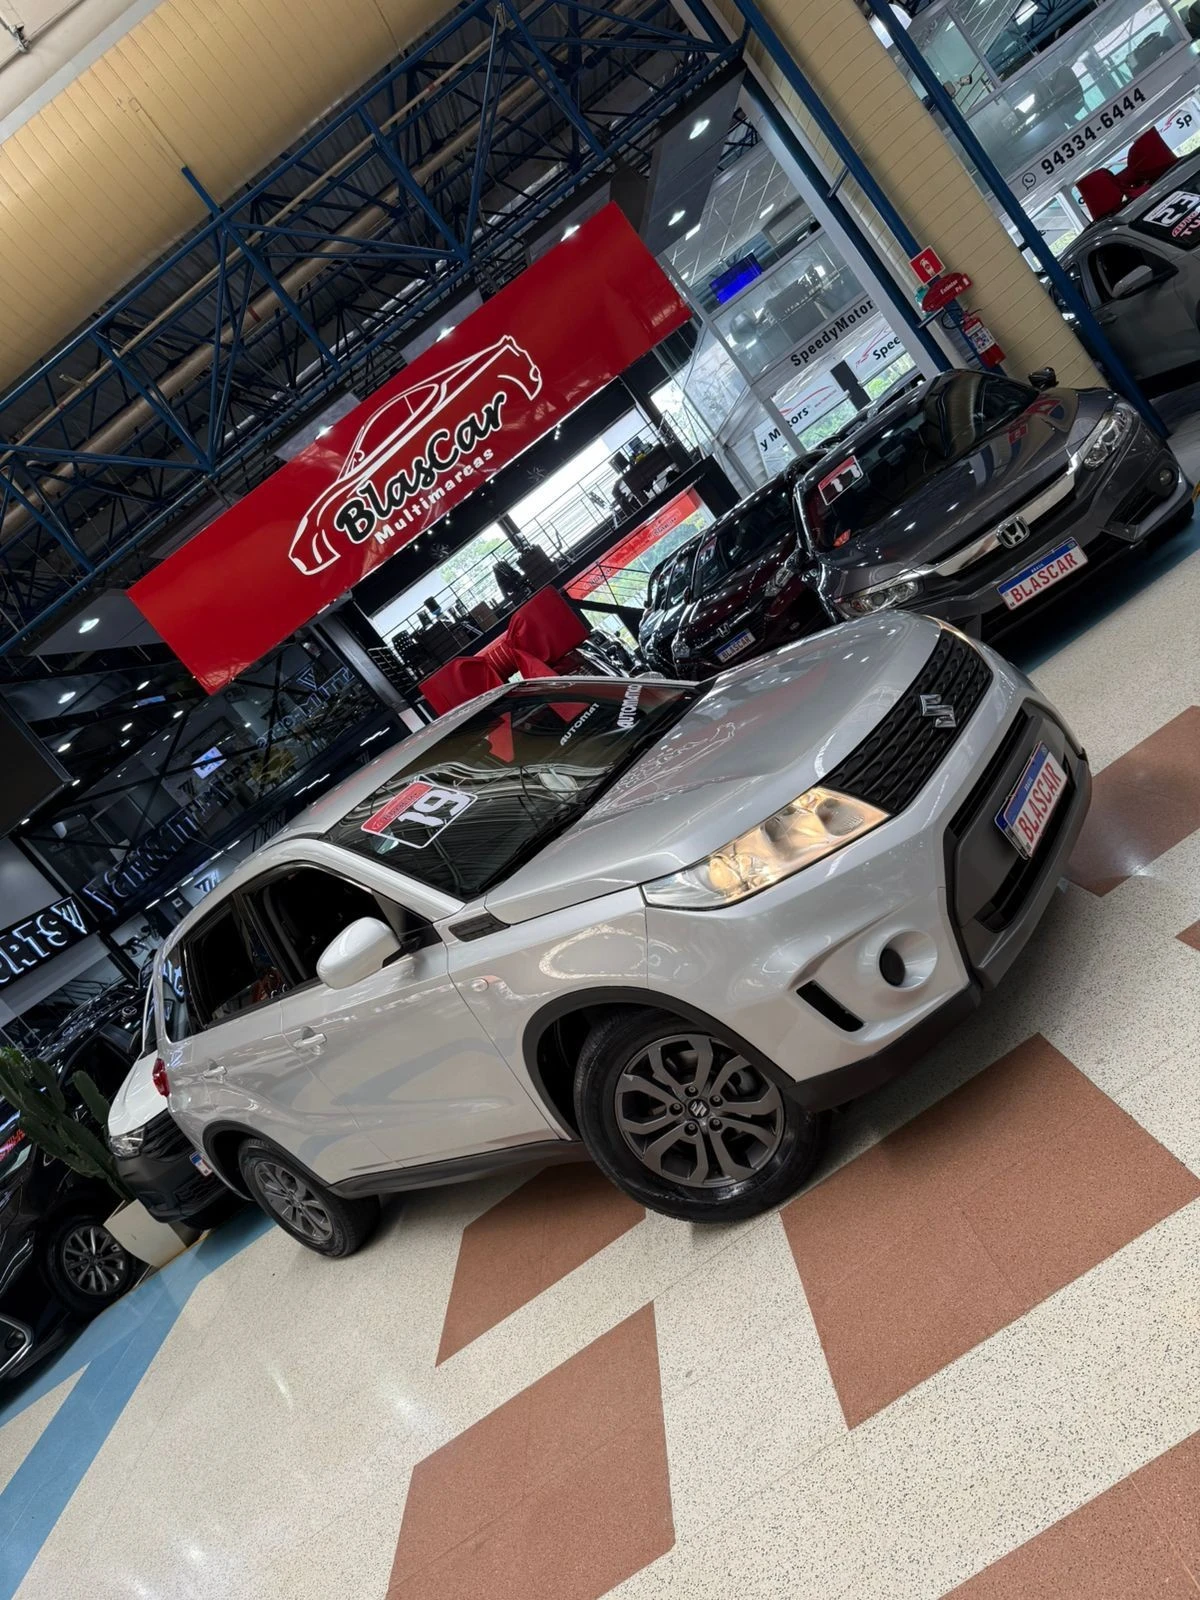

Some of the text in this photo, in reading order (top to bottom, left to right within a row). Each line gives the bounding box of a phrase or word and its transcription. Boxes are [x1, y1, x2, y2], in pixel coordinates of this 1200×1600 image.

[1041, 88, 1146, 175] 94334-6444
[1157, 195, 1200, 225] 23
[790, 299, 874, 367] SpeedyMotor
[334, 392, 507, 544] BlasCar
[373, 448, 494, 545] Multimarcas
[1009, 553, 1078, 603] BLASCAR
[722, 636, 750, 659] BLASCAR
[397, 789, 472, 827] 19
[1018, 762, 1062, 844] BLASCAR
